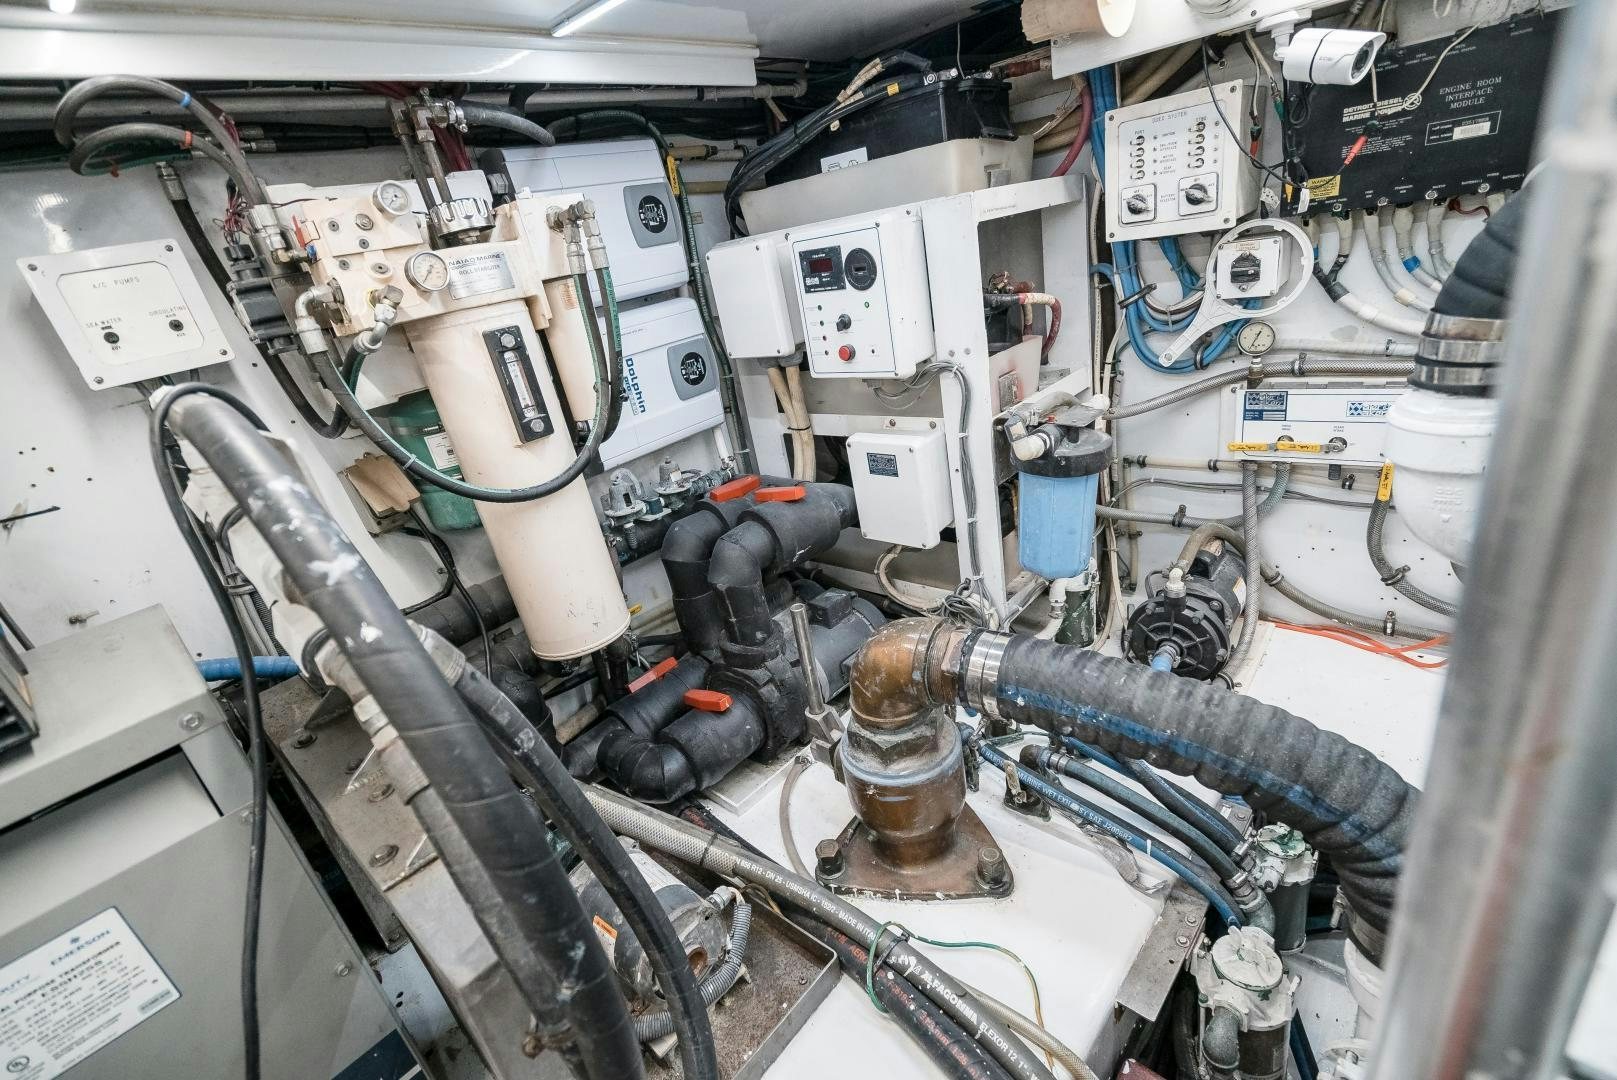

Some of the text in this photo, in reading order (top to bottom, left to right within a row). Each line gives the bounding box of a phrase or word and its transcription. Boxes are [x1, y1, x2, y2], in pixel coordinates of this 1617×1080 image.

[1439, 76, 1502, 95] ENGINE ROOM
[1445, 86, 1494, 102] INTERFACE
[1343, 97, 1403, 114] DETROIT DIESEL
[1449, 96, 1486, 109] MODULE
[1167, 111, 1187, 120] SYSTEM
[1342, 111, 1371, 122] MARINE
[92, 276, 141, 290] A/C PUMPS
[100, 317, 122, 326] WATER
[625, 357, 646, 413] Dolphin
[1017, 769, 1041, 790] MARINE
[1041, 785, 1057, 798] WET
[1057, 794, 1088, 816] EXHST
[751, 863, 763, 876] R12
[765, 869, 776, 881] DN
[838, 912, 858, 928] MADE
[857, 922, 865, 932] IN
[50, 929, 112, 966] EMERSON
[920, 970, 978, 1026] ALFAGOMMA
[1007, 1049, 1018, 1062] 12
